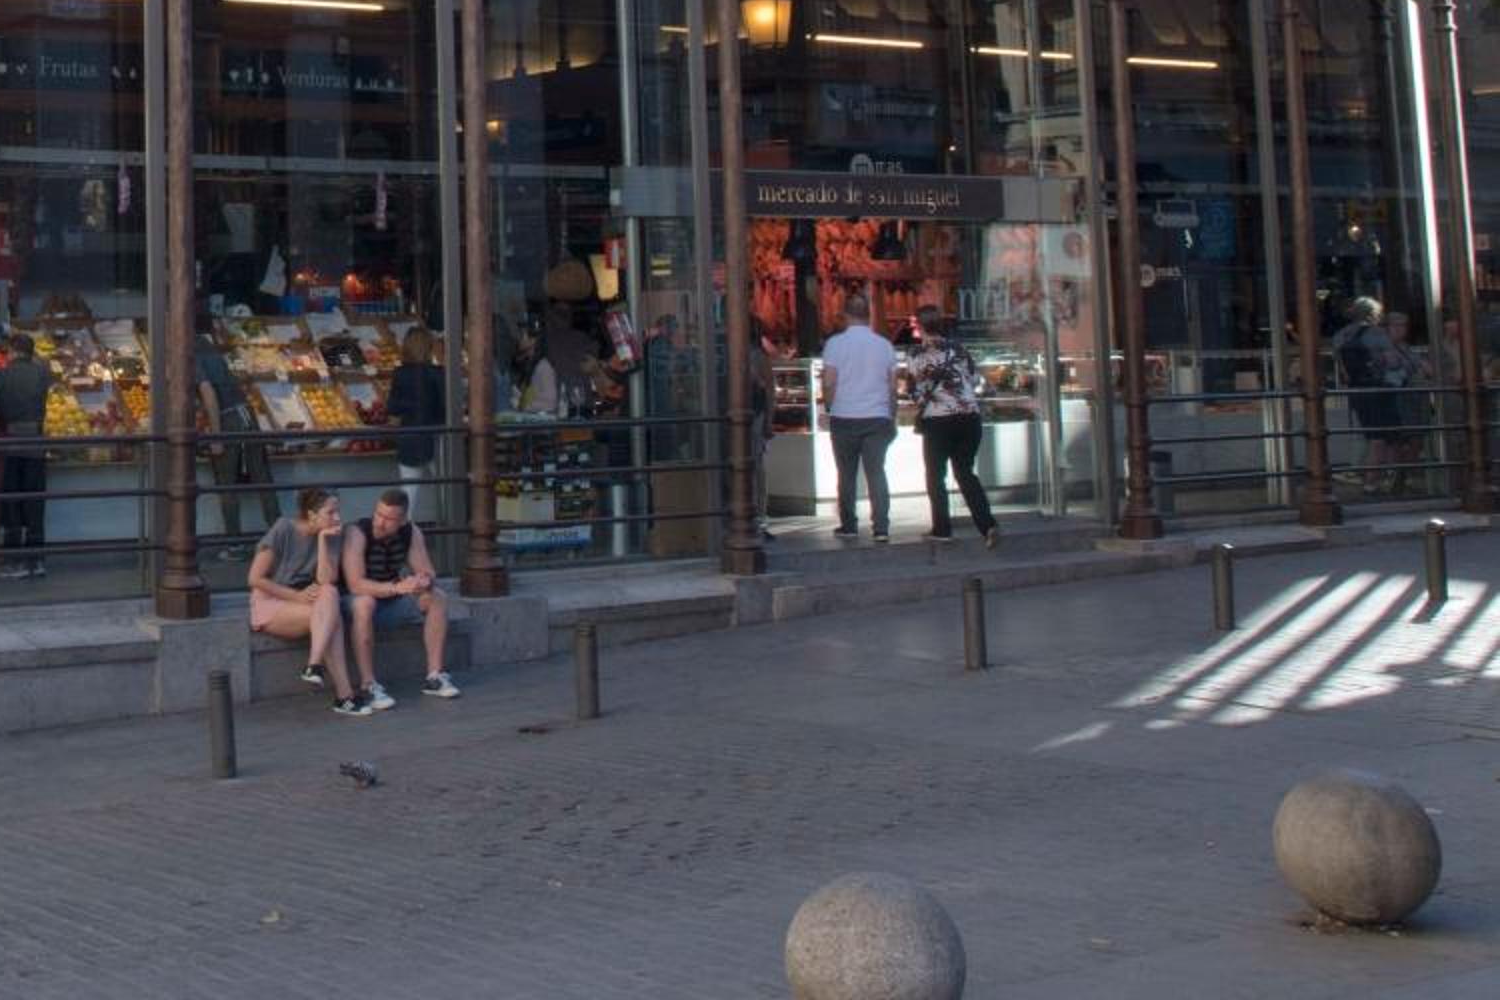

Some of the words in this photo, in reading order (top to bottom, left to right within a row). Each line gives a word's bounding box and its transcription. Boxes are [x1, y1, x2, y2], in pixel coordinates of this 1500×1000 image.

[38, 56, 99, 78] Frutas
[277, 64, 350, 88] Verduras
[757, 180, 838, 204] mercado
[842, 181, 862, 204] de
[868, 188, 898, 206] san
[902, 185, 961, 214] miguel
